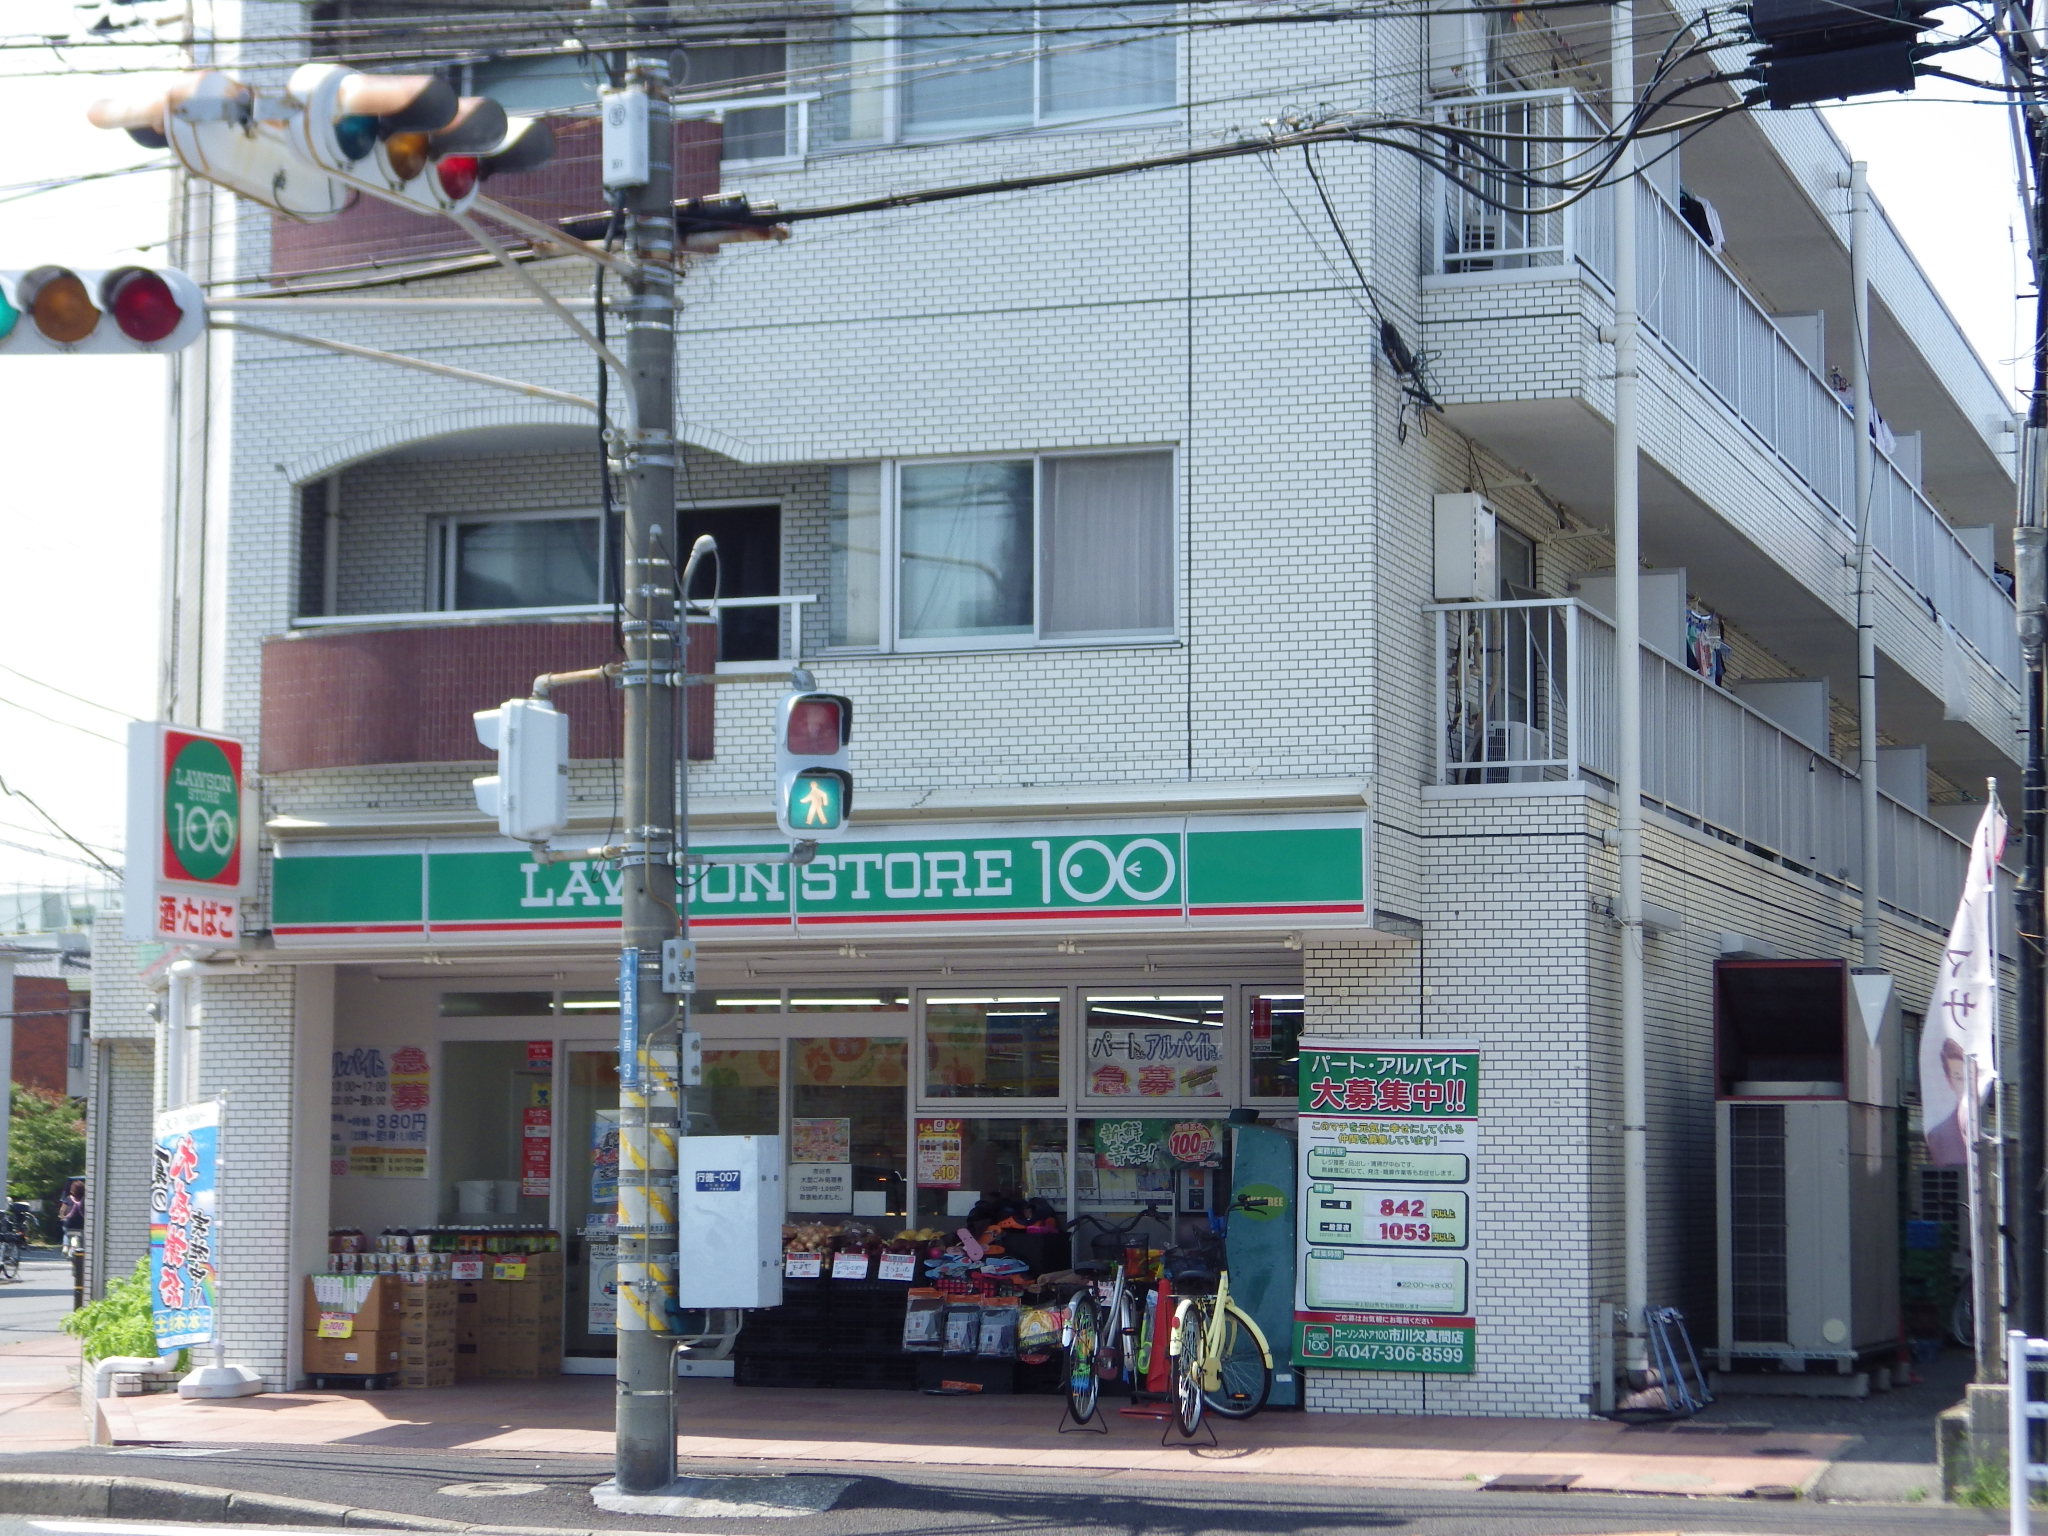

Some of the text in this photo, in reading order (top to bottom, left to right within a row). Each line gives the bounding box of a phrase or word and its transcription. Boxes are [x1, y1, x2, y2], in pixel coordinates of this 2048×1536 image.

[175, 768, 232, 792] LAWSON
[188, 789, 220, 804] STORE
[175, 803, 233, 855] 100
[520, 838, 1176, 907] LAON STORE 100
[159, 896, 234, 939] 酒・たばこ
[679, 971, 695, 983] 交通
[624, 1067, 632, 1078] 3
[1311, 1055, 1468, 1076] パート・アルバイト
[1092, 1065, 1176, 1096] 急募
[1310, 1076, 1467, 1112] 大募集中!!
[1099, 1120, 1143, 1145] 新鮮
[1311, 1121, 1465, 1135] このマチを元気に幸せにしてくれる
[697, 1172, 739, 1183] 行徳-007
[1380, 1198, 1425, 1217] 842
[1380, 1222, 1431, 1241] 1053
[1349, 1344, 1464, 1364] 047-306-8599
